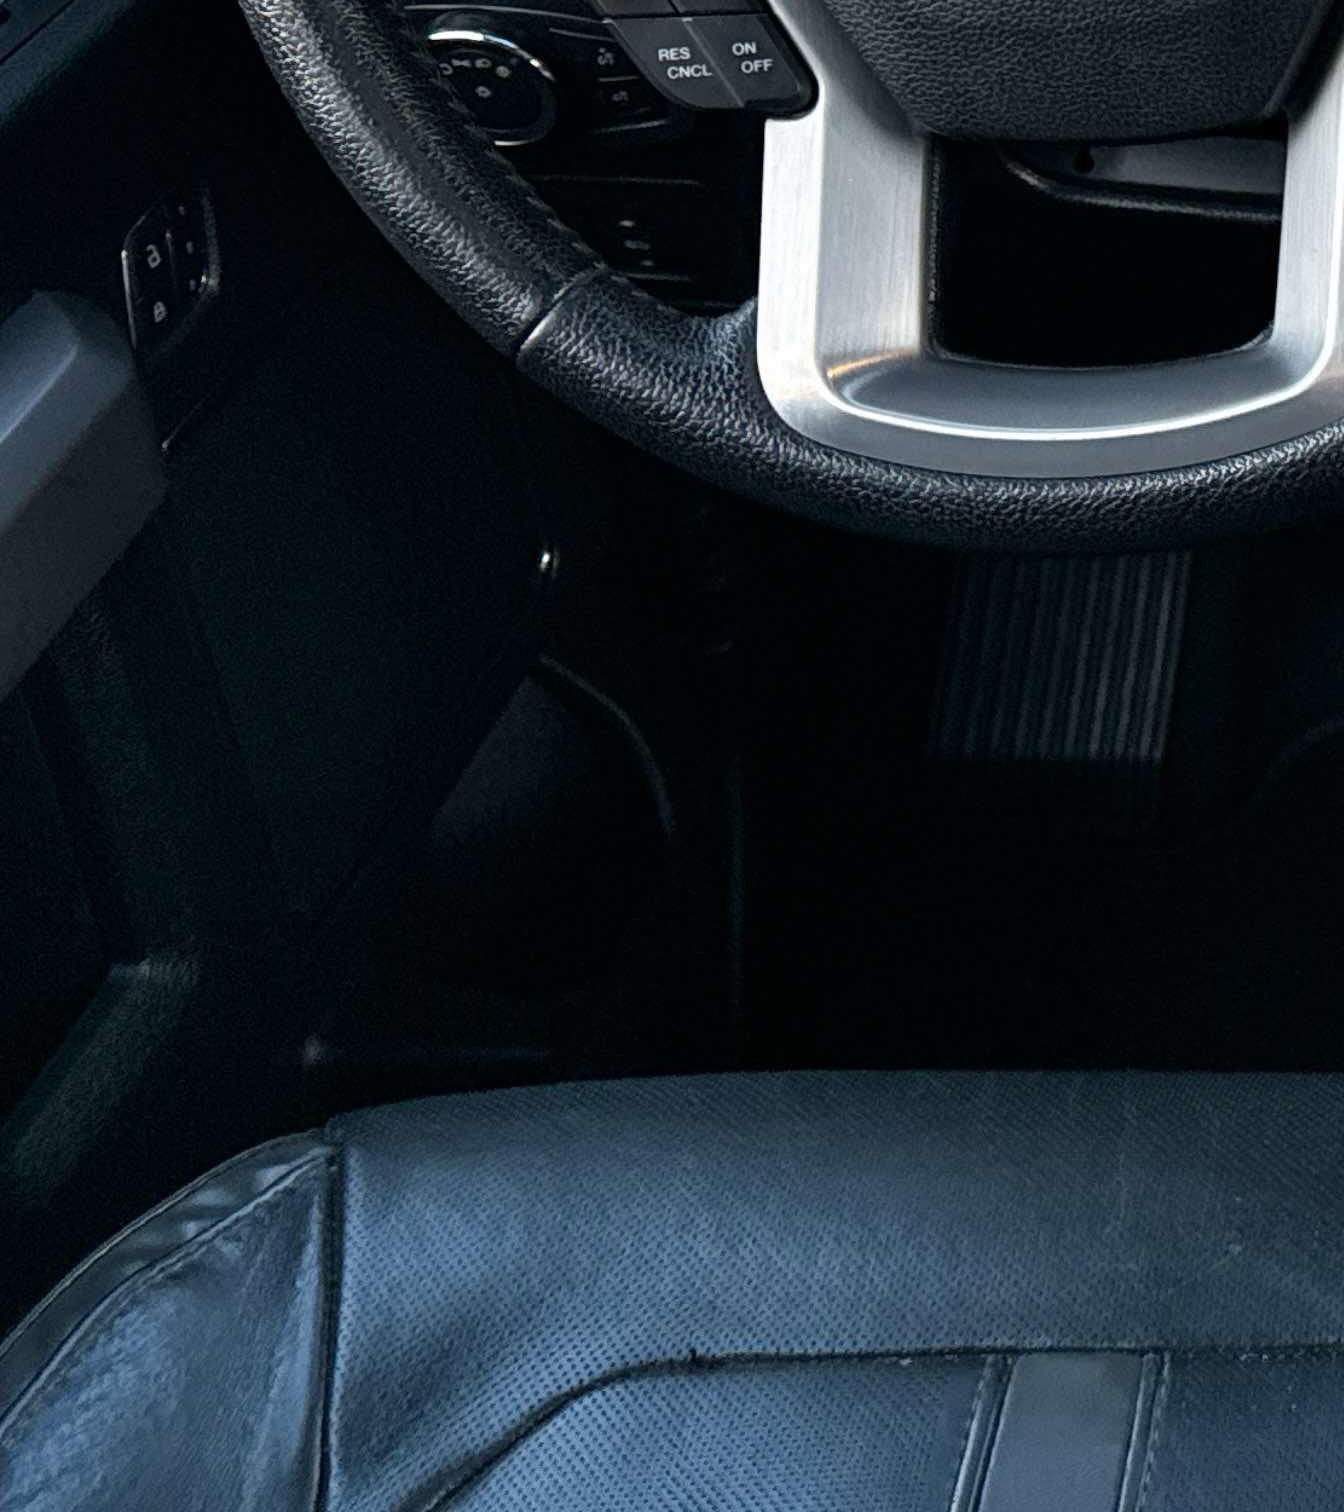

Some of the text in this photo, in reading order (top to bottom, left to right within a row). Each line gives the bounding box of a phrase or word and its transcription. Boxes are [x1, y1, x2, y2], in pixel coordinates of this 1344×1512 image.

[657, 46, 692, 61] RES
[732, 41, 757, 56] ON
[666, 64, 713, 79] CNCL
[741, 58, 773, 73] OFF
